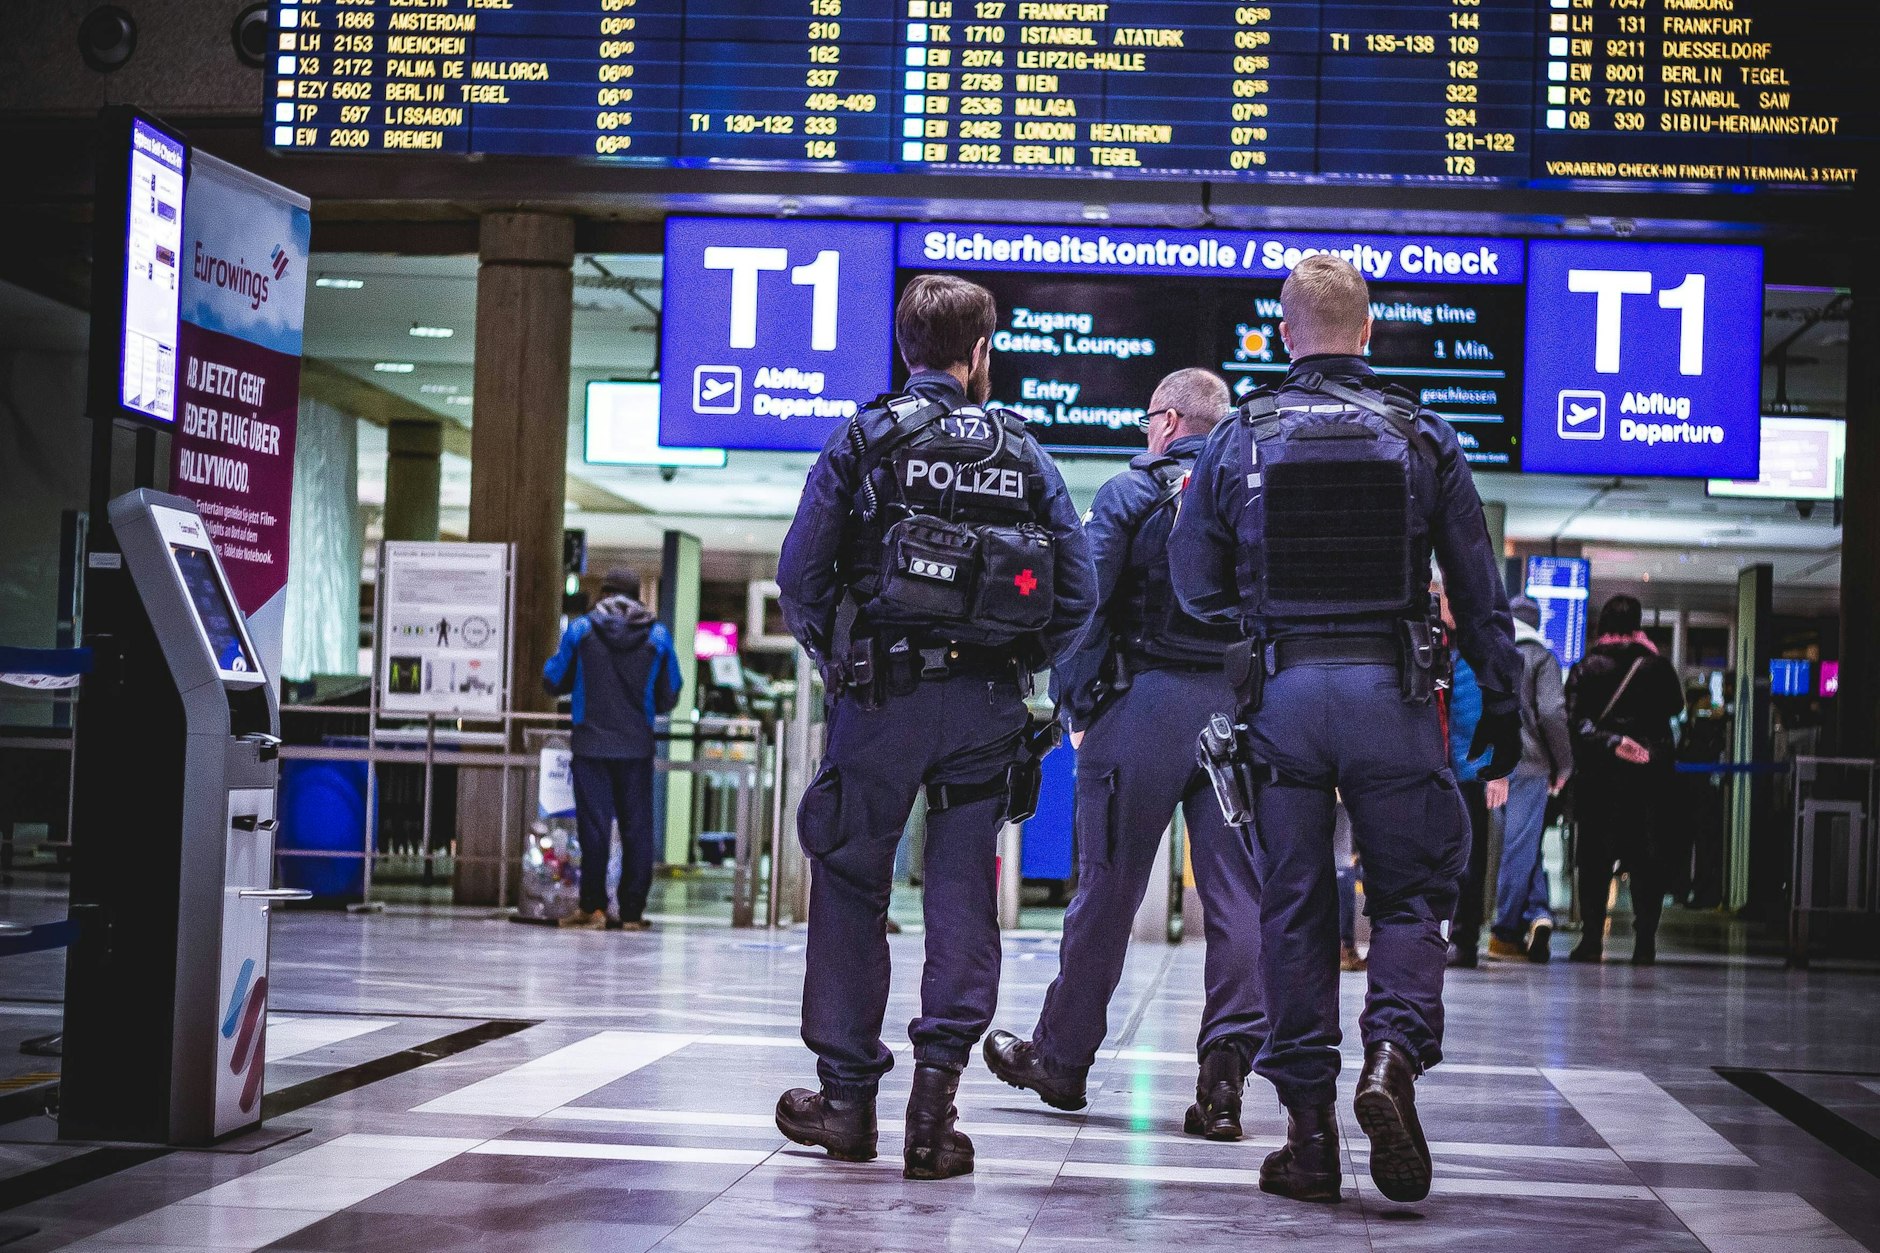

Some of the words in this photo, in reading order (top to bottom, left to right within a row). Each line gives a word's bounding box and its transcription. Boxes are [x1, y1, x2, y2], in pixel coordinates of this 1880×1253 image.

[301, 10, 321, 28] KL
[335, 11, 375, 29] 1866
[388, 13, 477, 31] AMSTERDAM
[808, 22, 841, 40] 310
[929, 1, 953, 18] LH
[974, 2, 1006, 19] 127
[1018, 2, 1109, 22] FRANKFURT
[1448, 12, 1480, 30] 144
[1572, 14, 1593, 33] LH
[1617, 15, 1646, 34] 131
[1664, 16, 1753, 36] FRANKFURT
[300, 33, 321, 52] LH
[333, 34, 374, 53] 2153
[387, 36, 466, 54] MUENCHEN
[807, 45, 840, 64] 162
[929, 24, 951, 42] TK
[963, 25, 1005, 43] 1710
[1021, 27, 1098, 46] ISTANBUL
[1113, 28, 1184, 48] ATATURK
[1330, 33, 1350, 51] T1
[1448, 36, 1479, 55] 109
[1571, 38, 1594, 57] EW
[1606, 39, 1645, 58] 9211
[1662, 41, 1772, 60] DUESSELDORF
[299, 57, 320, 75] X3
[332, 58, 373, 76] 2172
[386, 59, 436, 78] PALMA
[443, 60, 464, 78] DE
[472, 61, 549, 81] MALLORCA
[806, 69, 839, 87] 337
[927, 48, 951, 67] EW
[962, 49, 1005, 68] 2074
[1016, 51, 1147, 71] LEIPZIG-HALLE
[1447, 60, 1479, 79] 162
[1570, 63, 1593, 81] EW
[1605, 64, 1644, 83] 8001
[1662, 66, 1722, 84] BERLIN
[1740, 67, 1790, 86] TEGEL
[297, 81, 329, 99] EZY
[331, 82, 372, 100] 5602
[386, 83, 445, 101] BERLIN
[460, 85, 510, 104] TEGEL
[926, 72, 950, 90] EW
[1015, 75, 1059, 93] WIEN
[925, 96, 950, 114] EW
[1015, 98, 1077, 117] MALAGA
[1569, 87, 1591, 106] PC
[1604, 87, 1646, 107] 7210
[1664, 90, 1740, 109] ISTANBUL
[1759, 91, 1791, 109] SAW
[297, 104, 318, 122] TP
[340, 105, 371, 123] 597
[385, 107, 463, 126] LISSABON
[689, 113, 711, 132] T1
[724, 115, 795, 134] 130-132
[804, 116, 838, 135] 333
[1613, 111, 1646, 131] 330
[1660, 113, 1840, 135] SIBIU-HERMANNSTADT
[295, 127, 318, 146] EW
[329, 128, 370, 147] 2030
[384, 130, 444, 149] BREMEN
[803, 140, 837, 159] 164
[924, 119, 949, 138] EW
[1014, 122, 1077, 141] LONDON
[1090, 124, 1173, 144] HEATHROW
[1444, 131, 1516, 152] 121-122
[923, 143, 948, 162] EW
[958, 143, 1001, 163] 2012
[1013, 146, 1075, 165] BERLIN
[1090, 147, 1142, 167] TEGEL
[1443, 156, 1476, 175] 173
[1546, 161, 1617, 178] VORABEND
[1617, 162, 1677, 179] CHECK-IN
[1679, 164, 1725, 180] FINDET
[1726, 165, 1741, 180] IN
[1743, 166, 1808, 182] TERMINAL
[1810, 167, 1819, 181] 3
[1821, 168, 1858, 183] STATT
[924, 231, 1238, 269] Sicherheitskontrolle
[1242, 240, 1257, 269] /
[1400, 244, 1499, 275] Check
[194, 240, 270, 311] Eurowings
[703, 246, 841, 352] T1
[1436, 304, 1477, 323] time
[1011, 307, 1094, 334] Zugang
[1567, 269, 1706, 376] T1
[992, 330, 1061, 356] Gates,
[1063, 332, 1156, 359] Lounges
[1434, 339, 1447, 359] 1
[1455, 340, 1495, 361] Min.
[187, 356, 199, 388] AB
[199, 361, 238, 398] JETZT
[238, 371, 266, 407] GEHT
[754, 366, 825, 395] Abflug
[1021, 377, 1081, 405] Entry
[753, 394, 857, 421] Departure
[1619, 391, 1691, 420] Abflug
[183, 402, 218, 441] JEDER
[219, 411, 249, 449] FLUG
[249, 412, 281, 456] ÜBER
[1619, 419, 1725, 447] Departure
[905, 459, 1024, 499] POLIZEI
